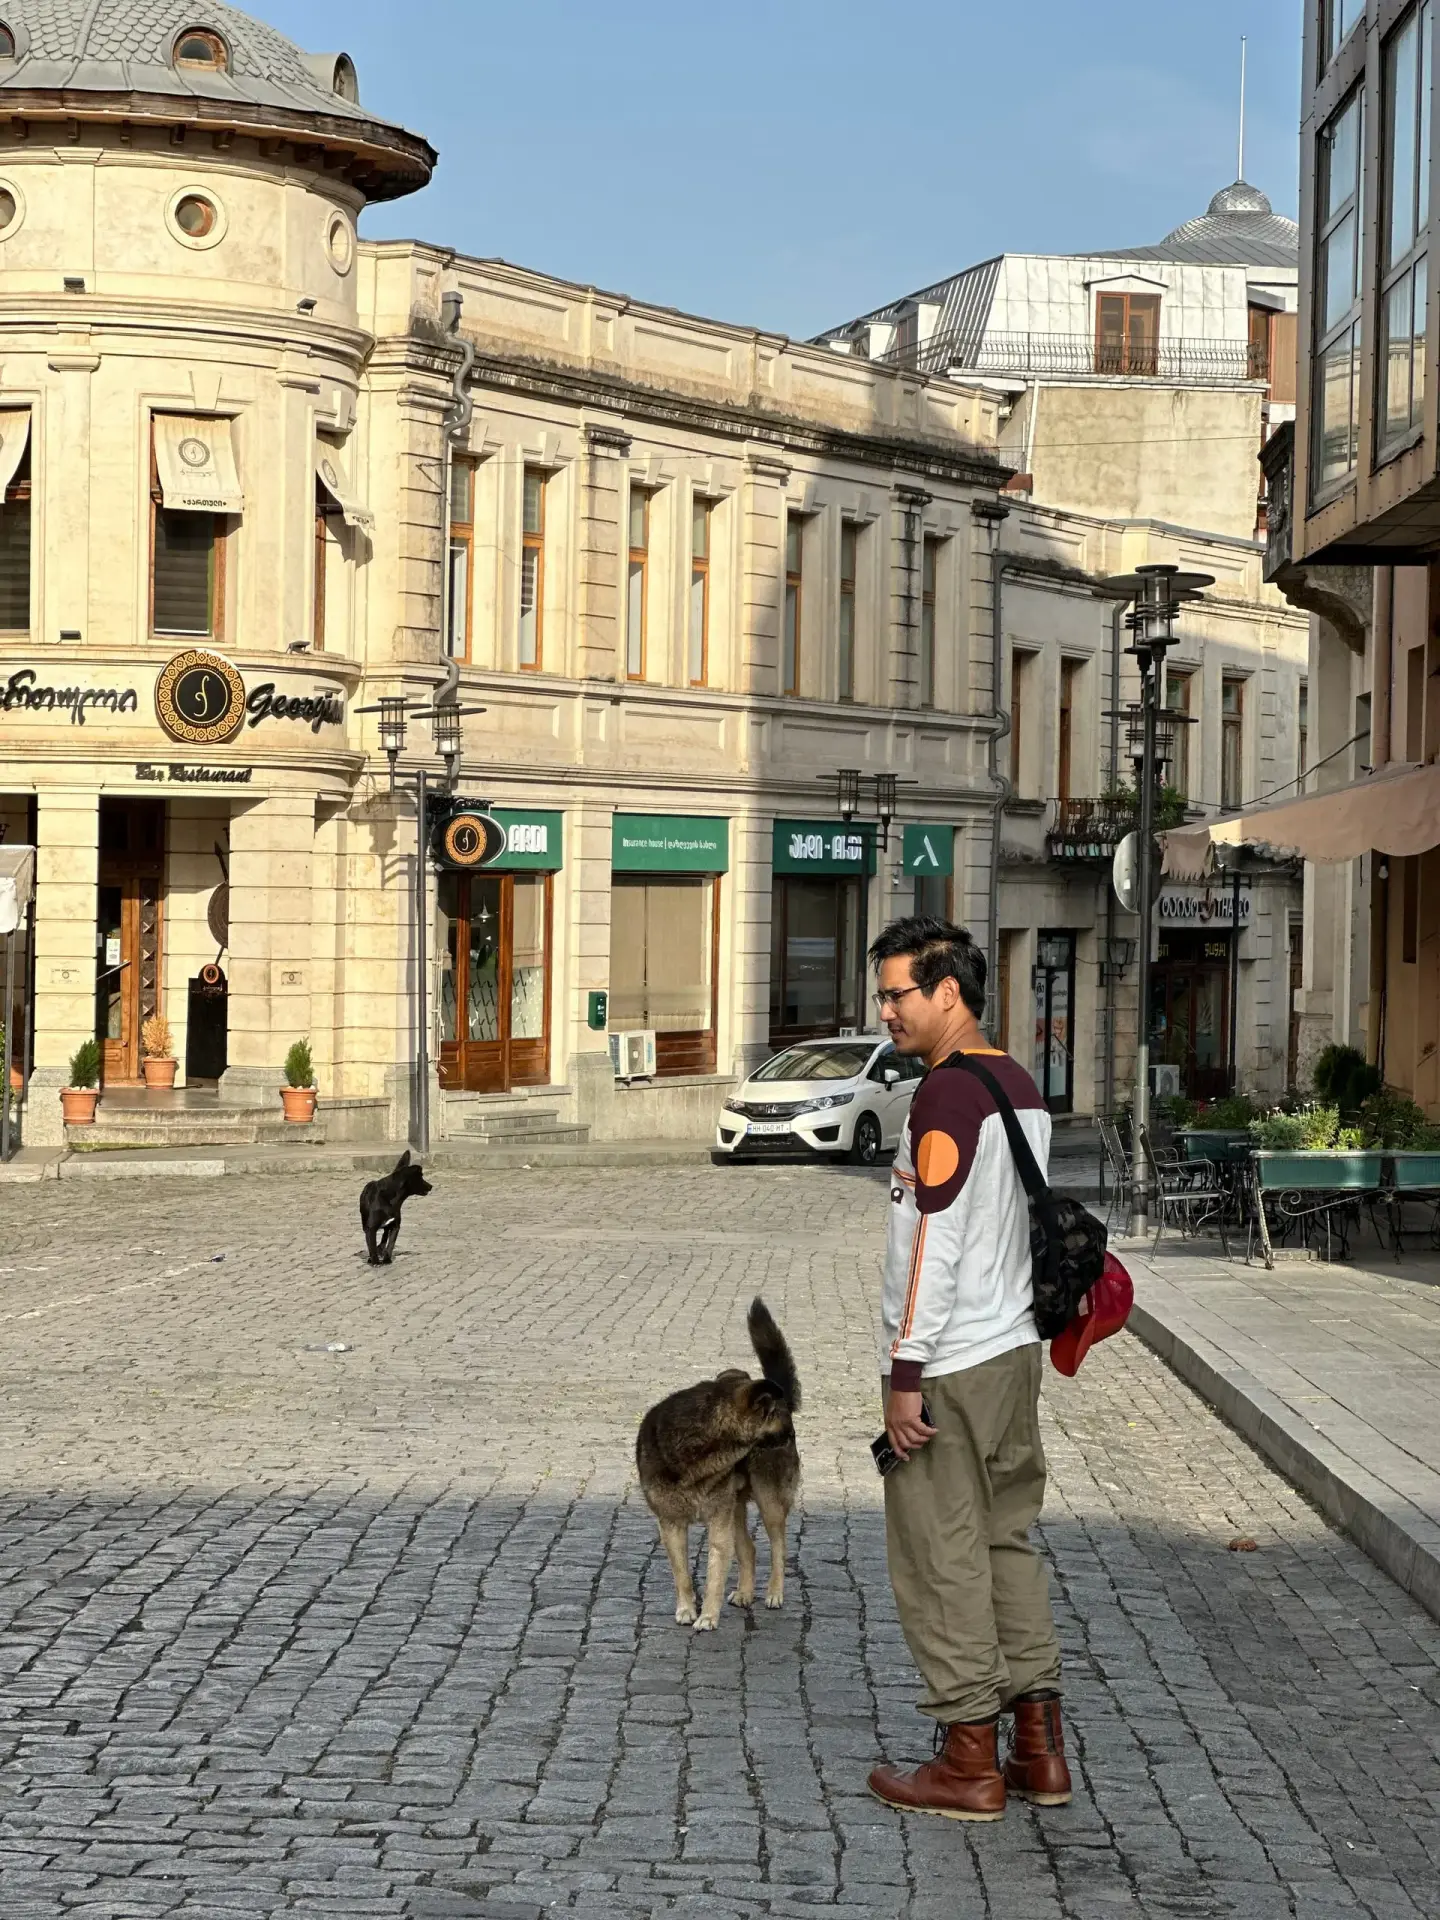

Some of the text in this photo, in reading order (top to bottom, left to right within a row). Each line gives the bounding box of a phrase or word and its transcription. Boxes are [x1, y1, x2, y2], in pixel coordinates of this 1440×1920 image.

[0, 669, 137, 726] რთული
[168, 764, 252, 783] Restaurant
[508, 824, 547, 853] ARDI
[622, 837, 647, 848] Insurance
[648, 838, 664, 848] house
[1214, 897, 1251, 918] THACO
